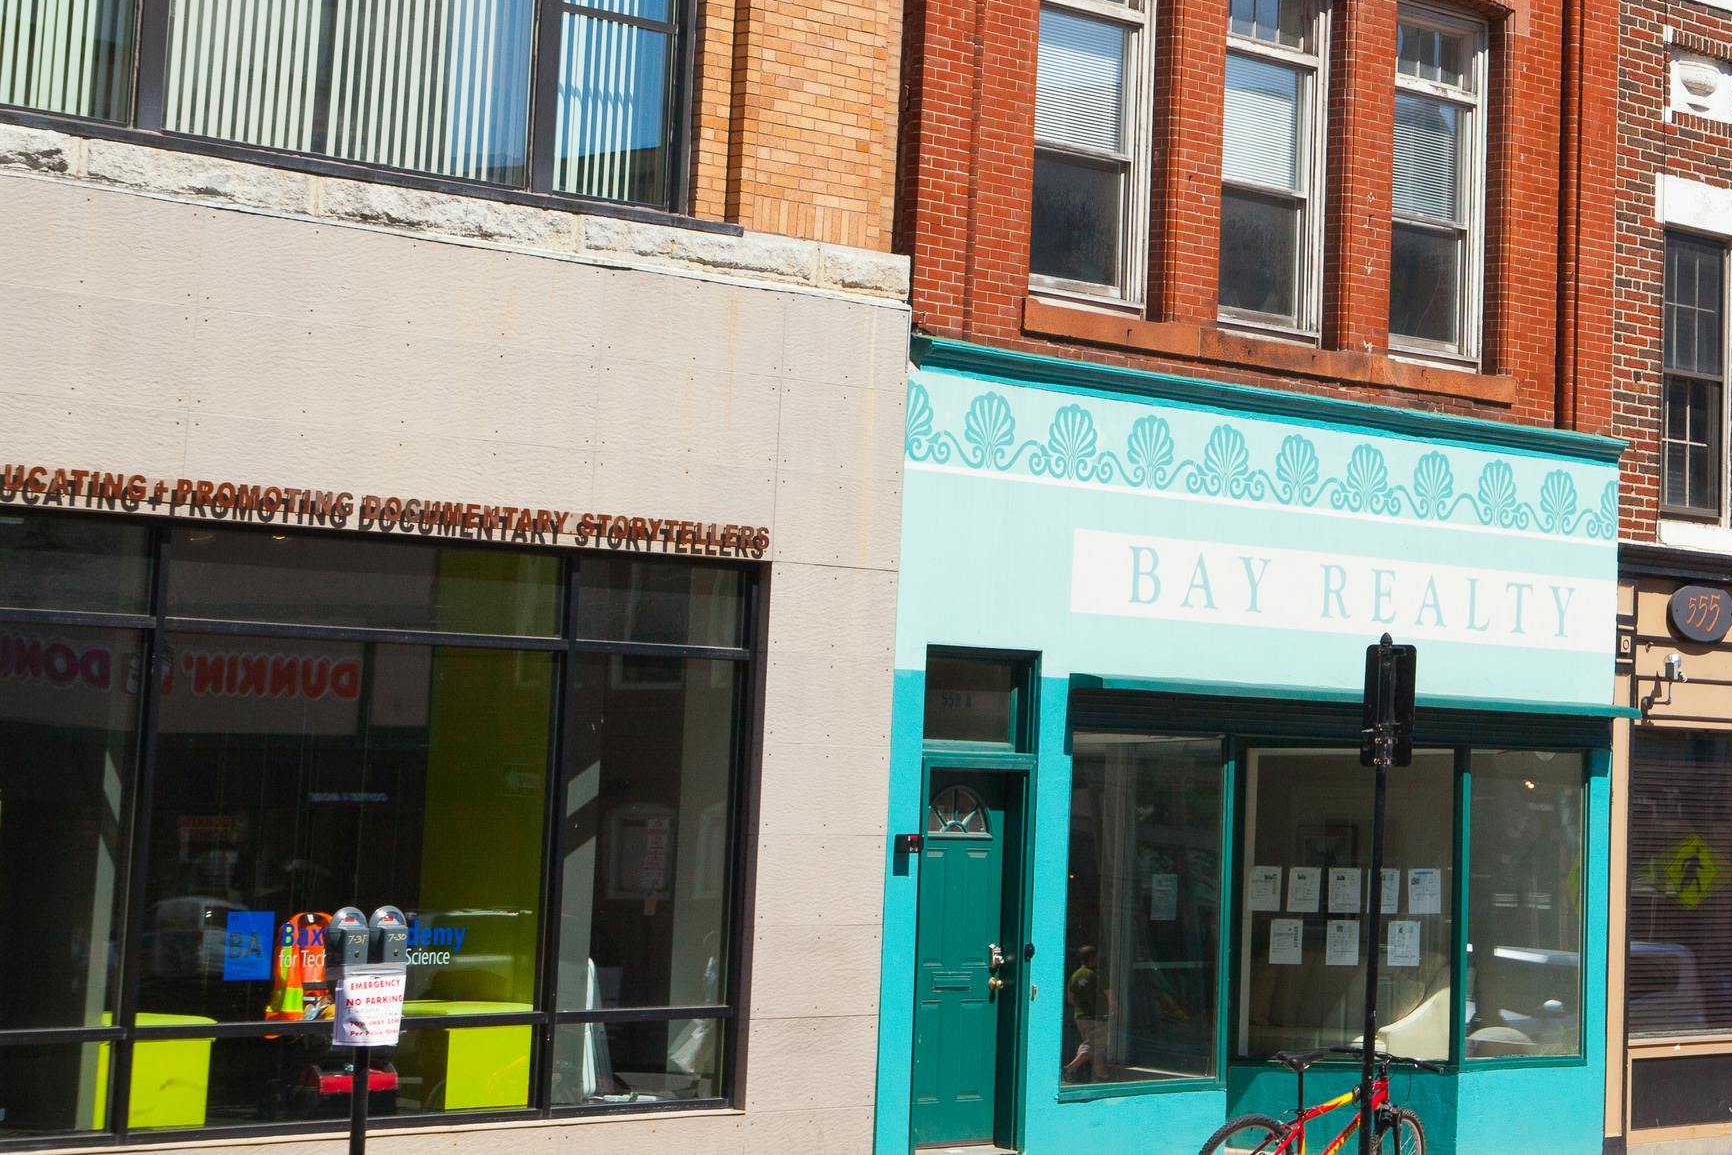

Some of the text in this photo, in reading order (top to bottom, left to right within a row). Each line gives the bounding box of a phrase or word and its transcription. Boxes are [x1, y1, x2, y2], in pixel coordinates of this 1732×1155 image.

[177, 479, 354, 517] PROMOTING
[363, 495, 570, 534] DOCUMENTARY
[582, 512, 770, 550] STORYTELLERS
[1128, 545, 1576, 638] BAY REALTY
[1687, 593, 1721, 632] 555
[228, 931, 263, 960] BA
[407, 919, 467, 954] demy
[279, 949, 298, 969] for
[405, 948, 451, 966] Science
[346, 995, 403, 1007] NO PARKING
[350, 979, 401, 991] EMERGENCY
